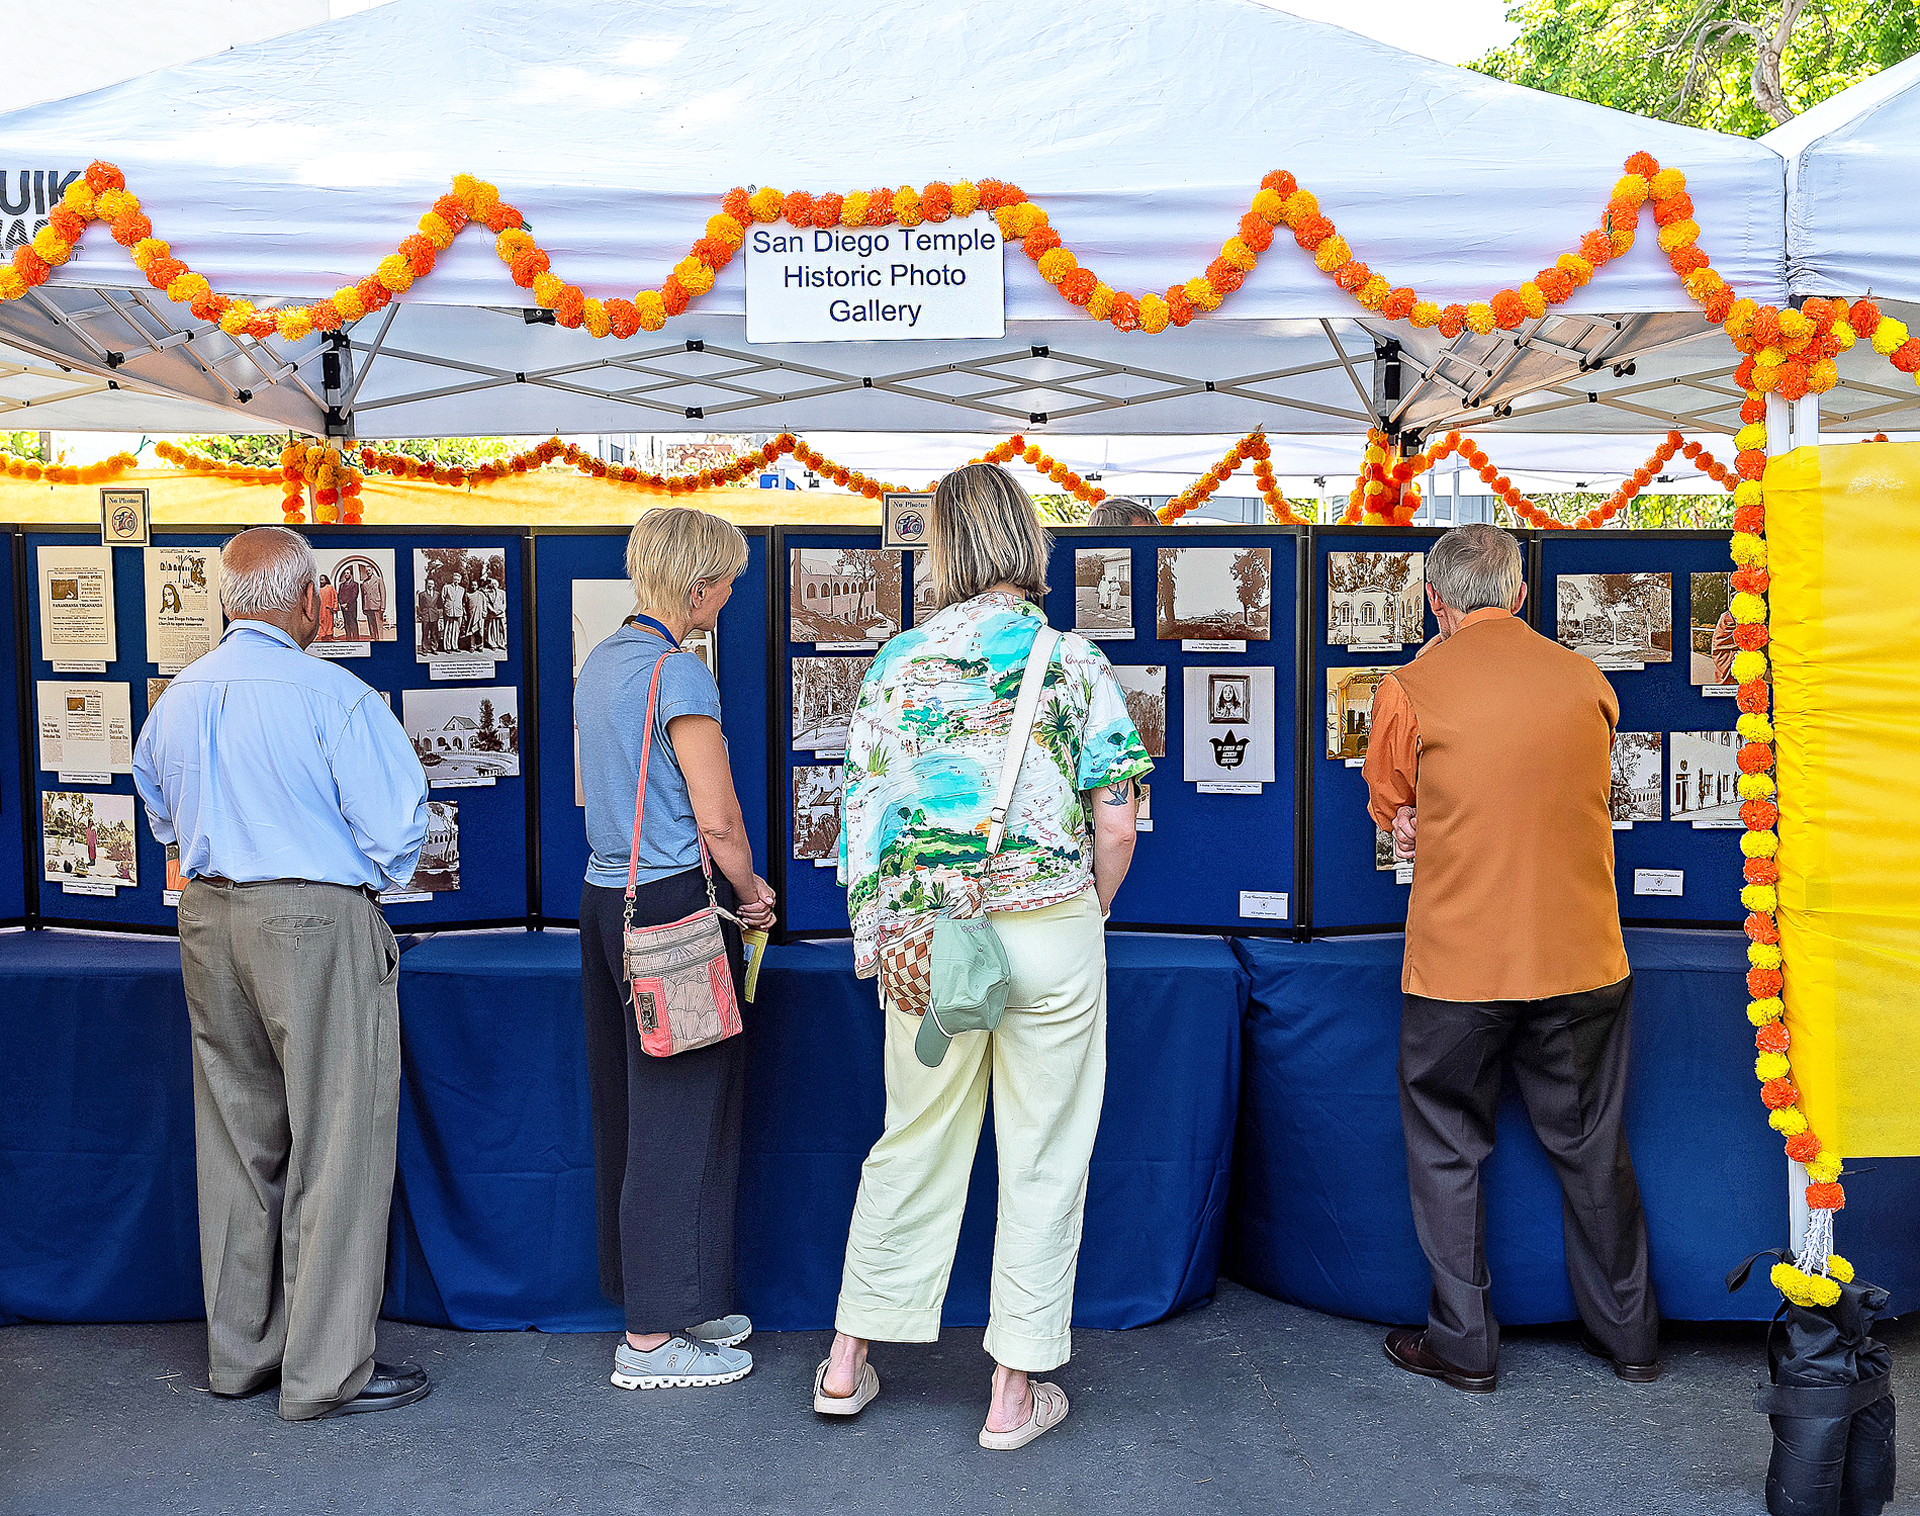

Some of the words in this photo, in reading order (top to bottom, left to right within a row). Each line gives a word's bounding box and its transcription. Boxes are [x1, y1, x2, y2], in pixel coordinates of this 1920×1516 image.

[753, 230, 803, 253] San
[814, 230, 889, 257] Diego
[898, 228, 995, 256] Temple
[784, 264, 881, 287] Historic
[890, 263, 966, 286] Photo
[829, 298, 922, 327] Gallery
[109, 496, 118, 504] No
